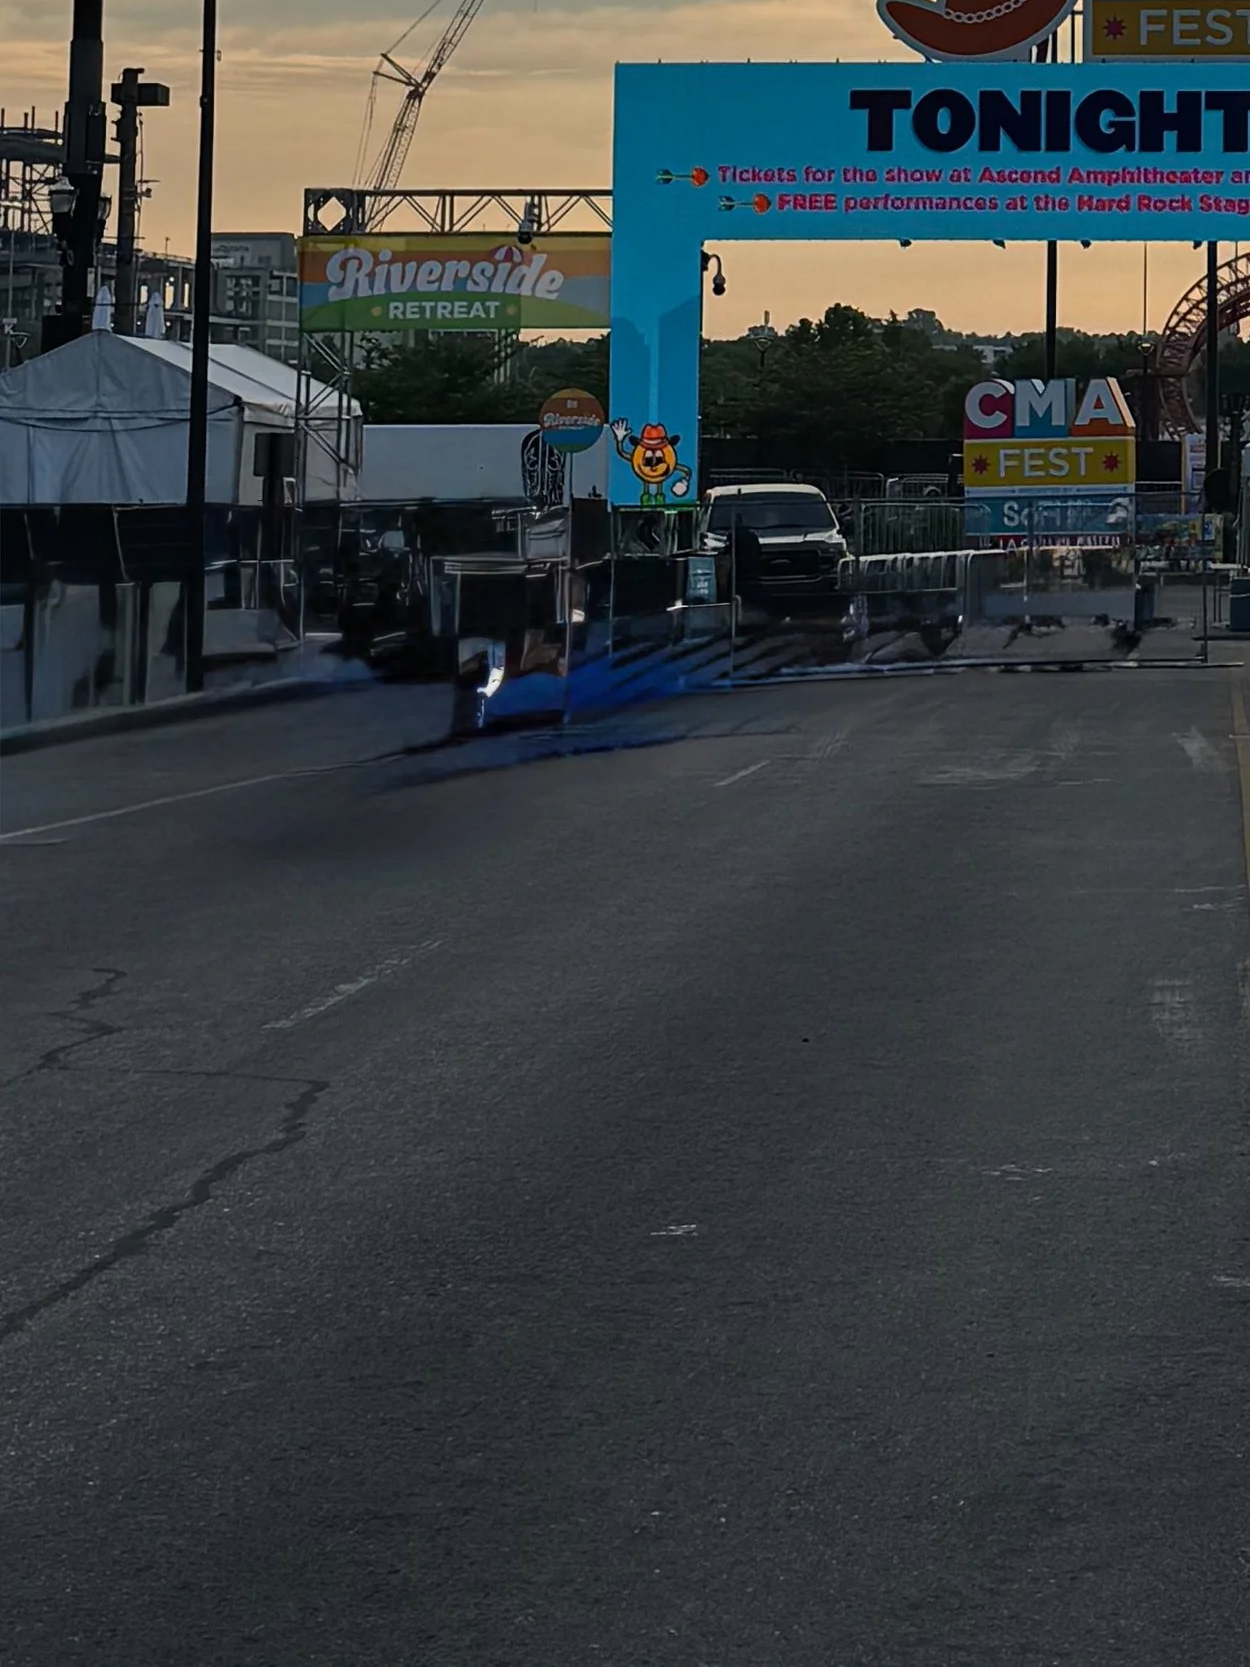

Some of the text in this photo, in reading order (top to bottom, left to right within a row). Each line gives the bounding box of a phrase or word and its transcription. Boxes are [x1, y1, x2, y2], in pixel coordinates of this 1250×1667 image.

[718, 166, 797, 184] Tickets
[804, 166, 836, 184] for
[842, 166, 878, 184] the
[885, 167, 942, 184] show
[949, 167, 972, 184] at
[978, 166, 1062, 184] Ascend
[1067, 166, 1224, 186] Amphitheater
[775, 193, 838, 211] FREE
[844, 194, 998, 214] performances
[1005, 194, 1028, 211] at
[1033, 194, 1070, 211] the
[1077, 194, 1131, 212] Hard
[1137, 194, 1192, 212] Rock
[325, 246, 565, 301] Riverside
[388, 301, 500, 320] RETREAT
[964, 377, 1128, 429] CMA
[999, 447, 1094, 478] FEST
